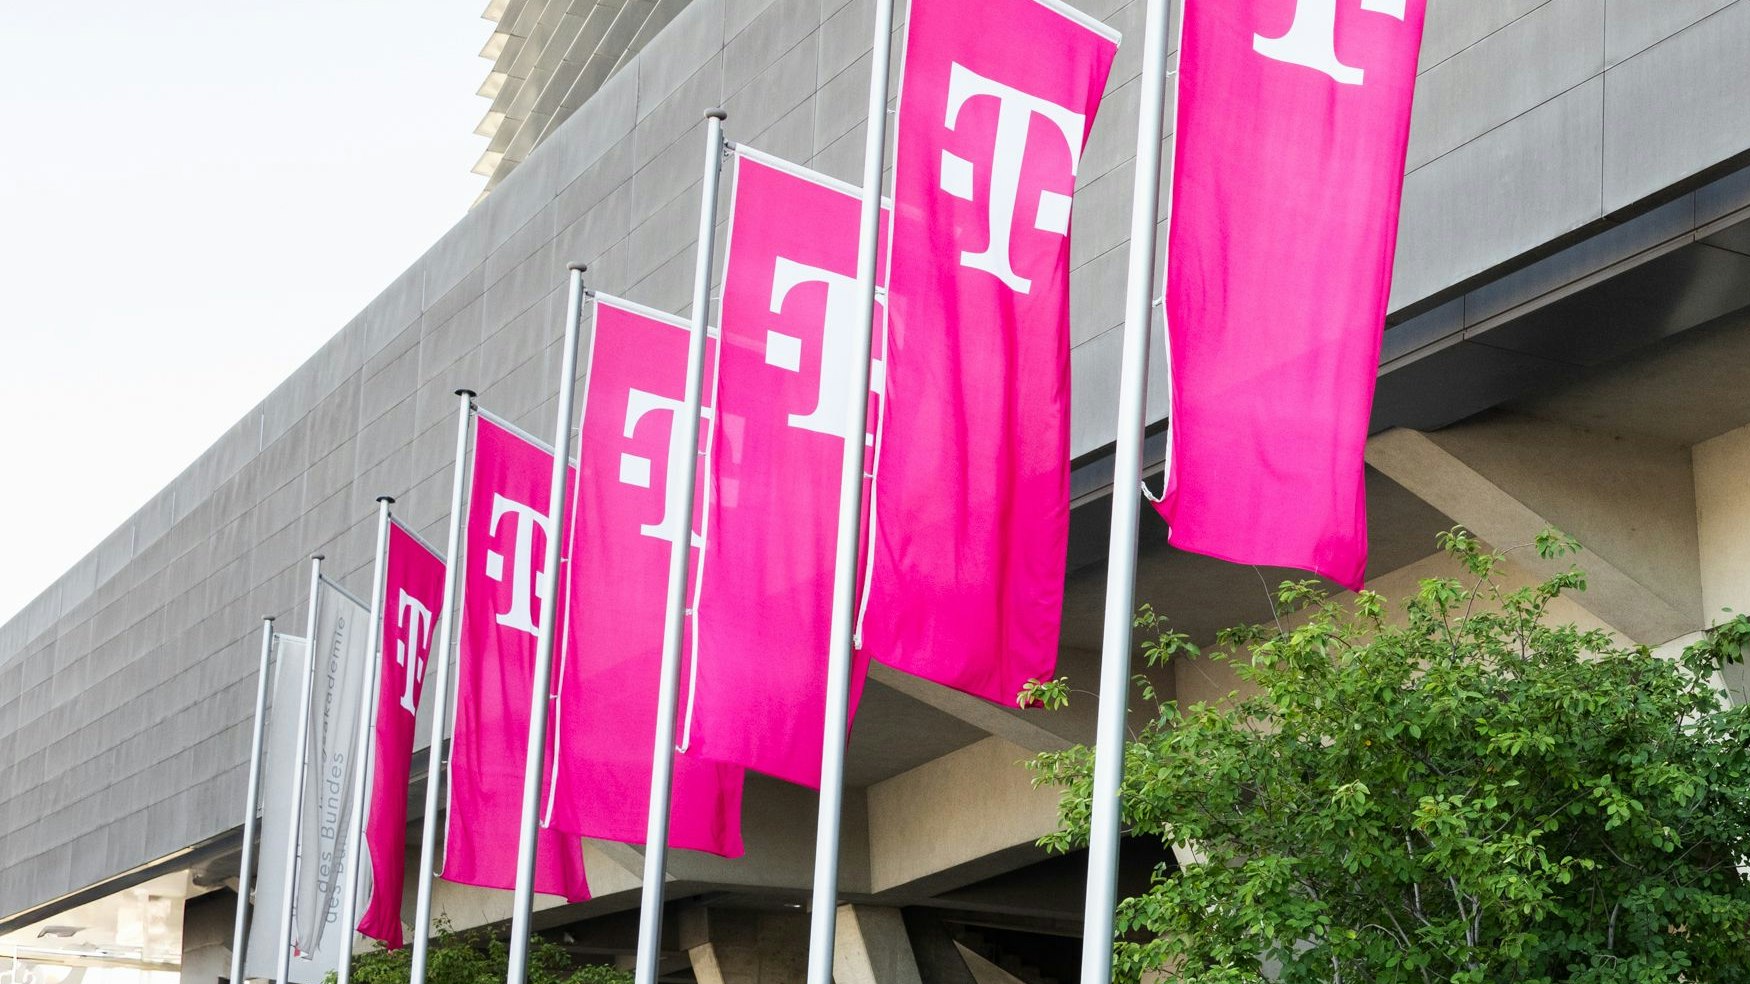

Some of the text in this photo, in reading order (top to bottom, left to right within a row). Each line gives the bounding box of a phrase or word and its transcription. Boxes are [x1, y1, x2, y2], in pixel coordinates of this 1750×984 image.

[940, 61, 1086, 295] T
[486, 492, 552, 637] T
[397, 587, 432, 717] T
[321, 752, 344, 840] Bundes
